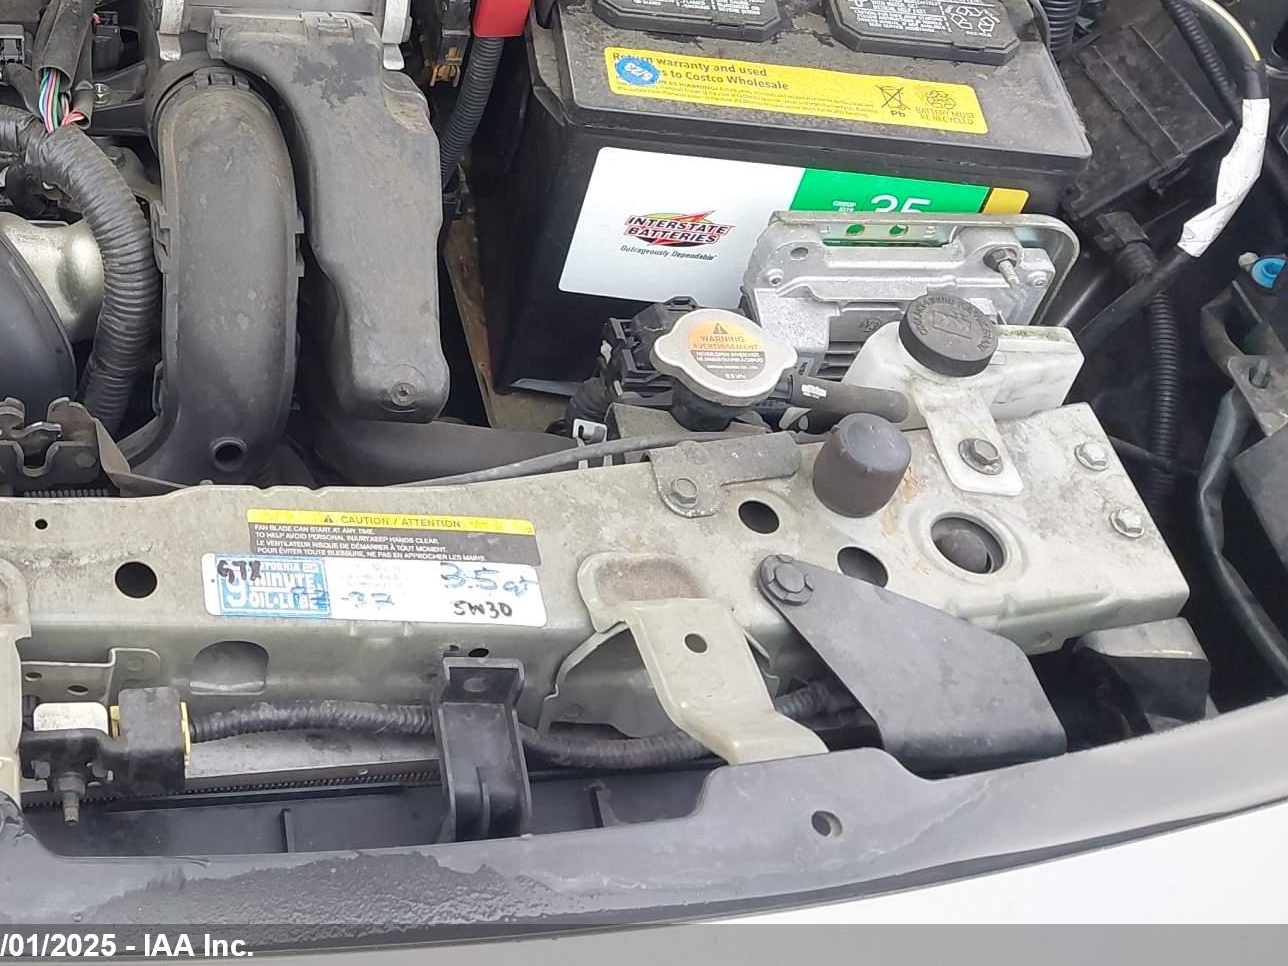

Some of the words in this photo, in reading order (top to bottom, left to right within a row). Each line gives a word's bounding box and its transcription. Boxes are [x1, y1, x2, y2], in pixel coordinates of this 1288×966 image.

[656, 57, 710, 73] warranty
[714, 64, 736, 73] and
[740, 66, 768, 76] used
[672, 70, 682, 78] to
[685, 72, 724, 83] Costco
[727, 76, 789, 90] Wholesale
[916, 107, 950, 116] BATTERY
[934, 116, 974, 124] RECYCLED
[628, 217, 728, 234] INTERSTATE
[628, 227, 718, 243] BATTERIES
[620, 244, 670, 257] Outrageously
[340, 516, 388, 525] CAUTION
[402, 518, 461, 528] ATTENTION
